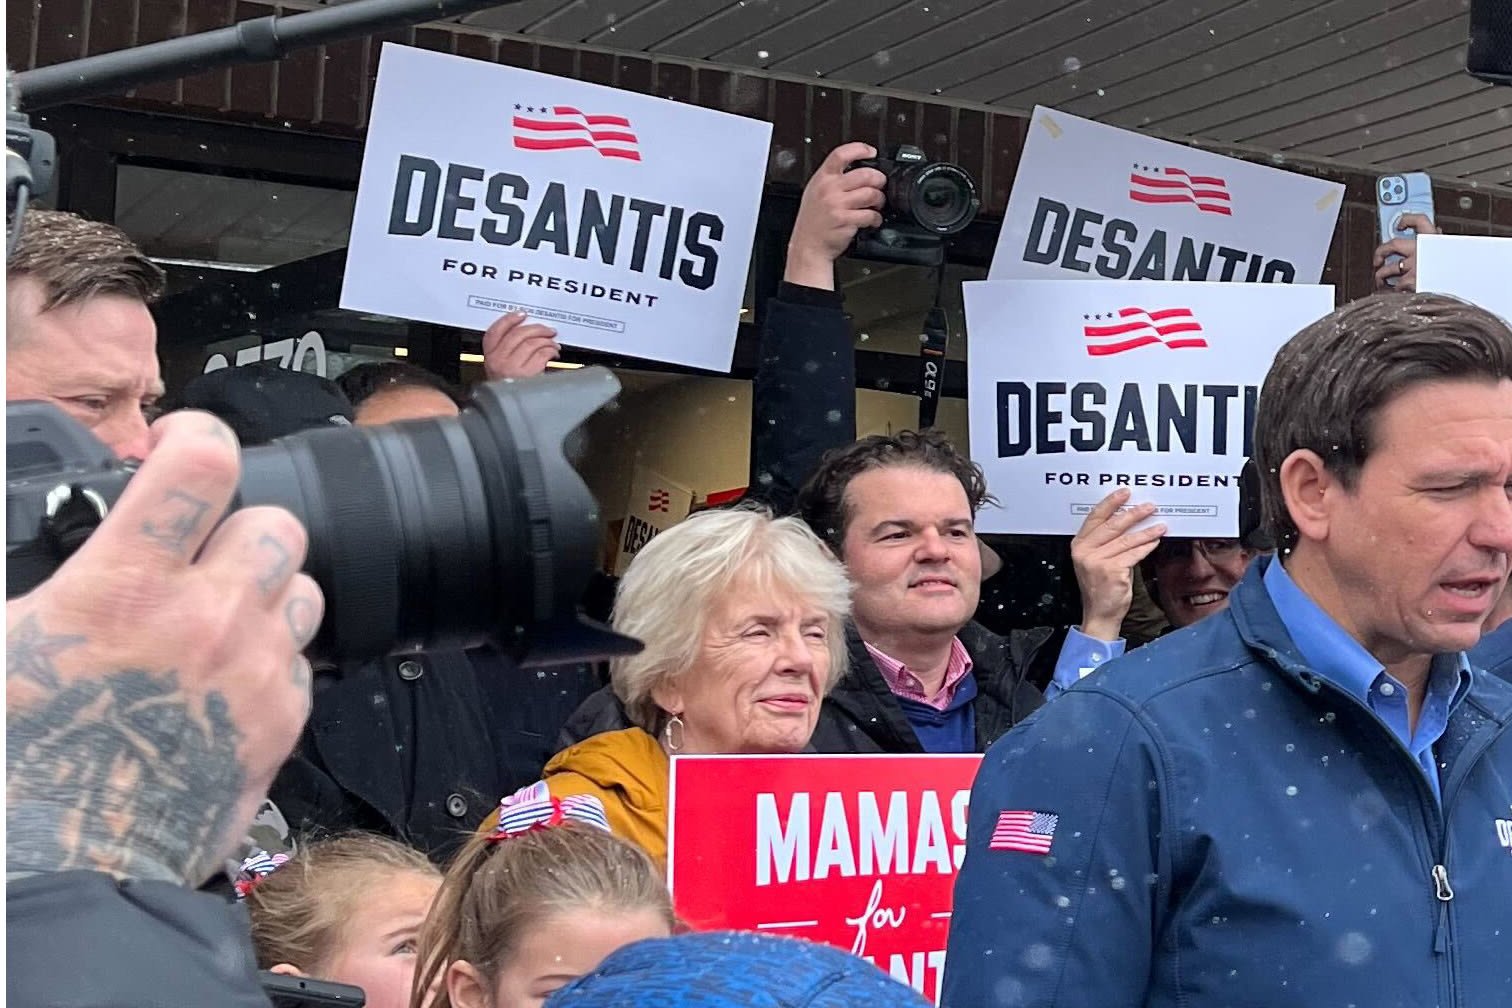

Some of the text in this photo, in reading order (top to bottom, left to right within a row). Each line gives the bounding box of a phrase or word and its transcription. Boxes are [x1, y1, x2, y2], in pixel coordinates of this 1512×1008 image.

[388, 154, 725, 291] DESANTIS
[442, 258, 659, 307] FOR PRESIDENT
[1045, 472, 1089, 486] FOR
